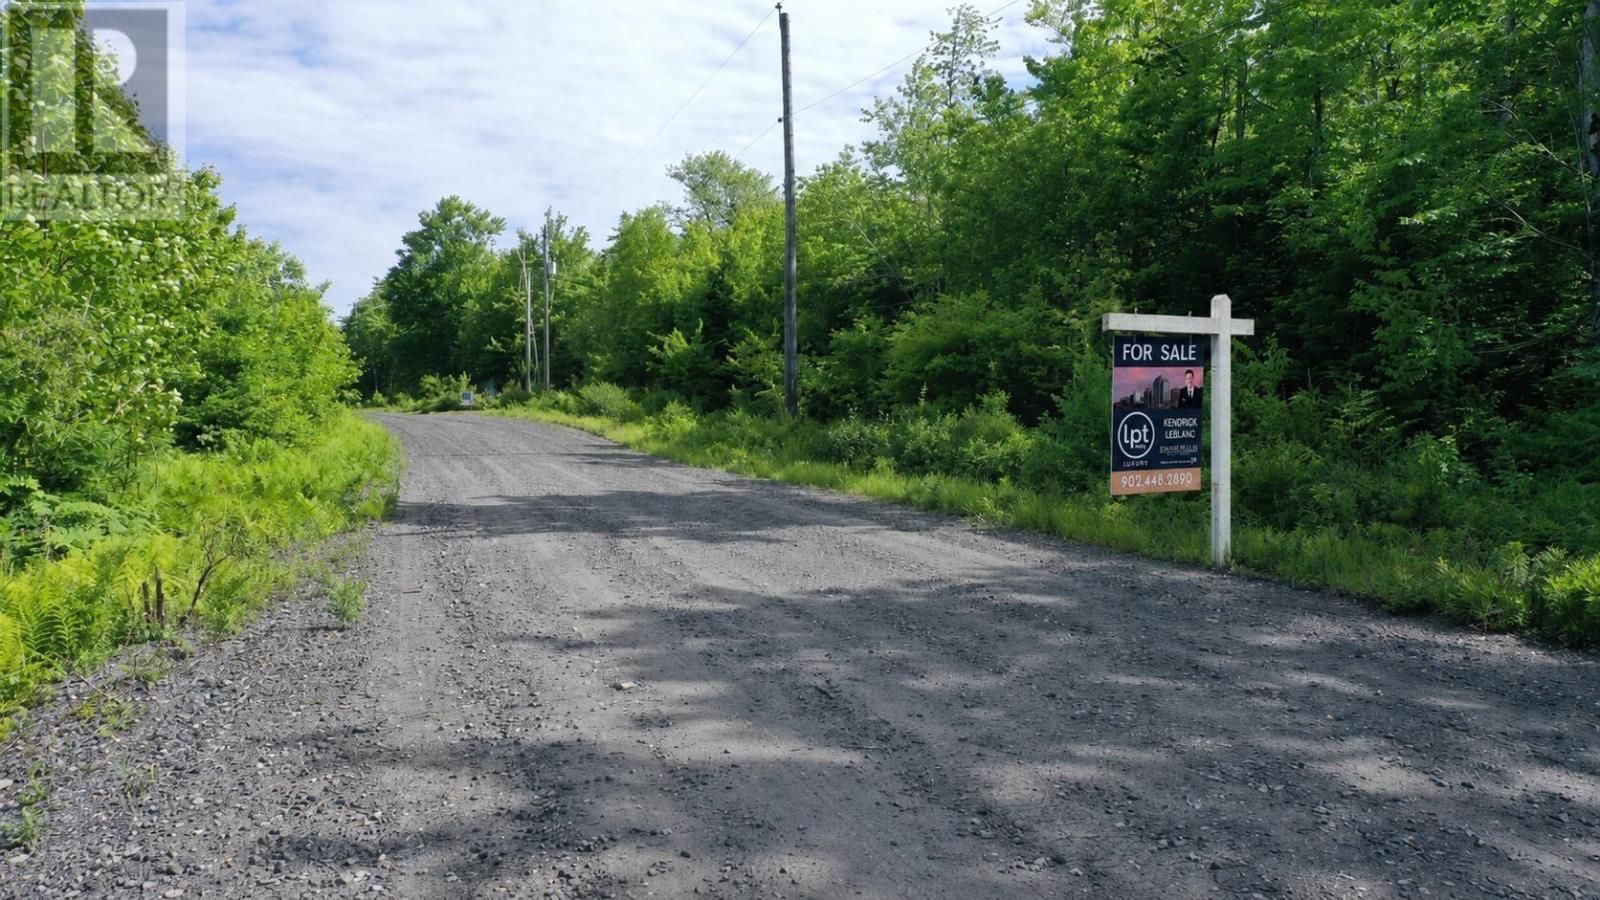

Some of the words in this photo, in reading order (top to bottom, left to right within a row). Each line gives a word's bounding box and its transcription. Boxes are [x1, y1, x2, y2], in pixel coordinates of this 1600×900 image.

[1123, 344, 1152, 361] FOR
[1161, 344, 1197, 361] SALE
[1163, 418, 1198, 428] KENDRICK
[1165, 430, 1196, 440] LEBLANC
[1123, 460, 1149, 468] LUXURY
[1121, 473, 1192, 487] 902.448.2890
